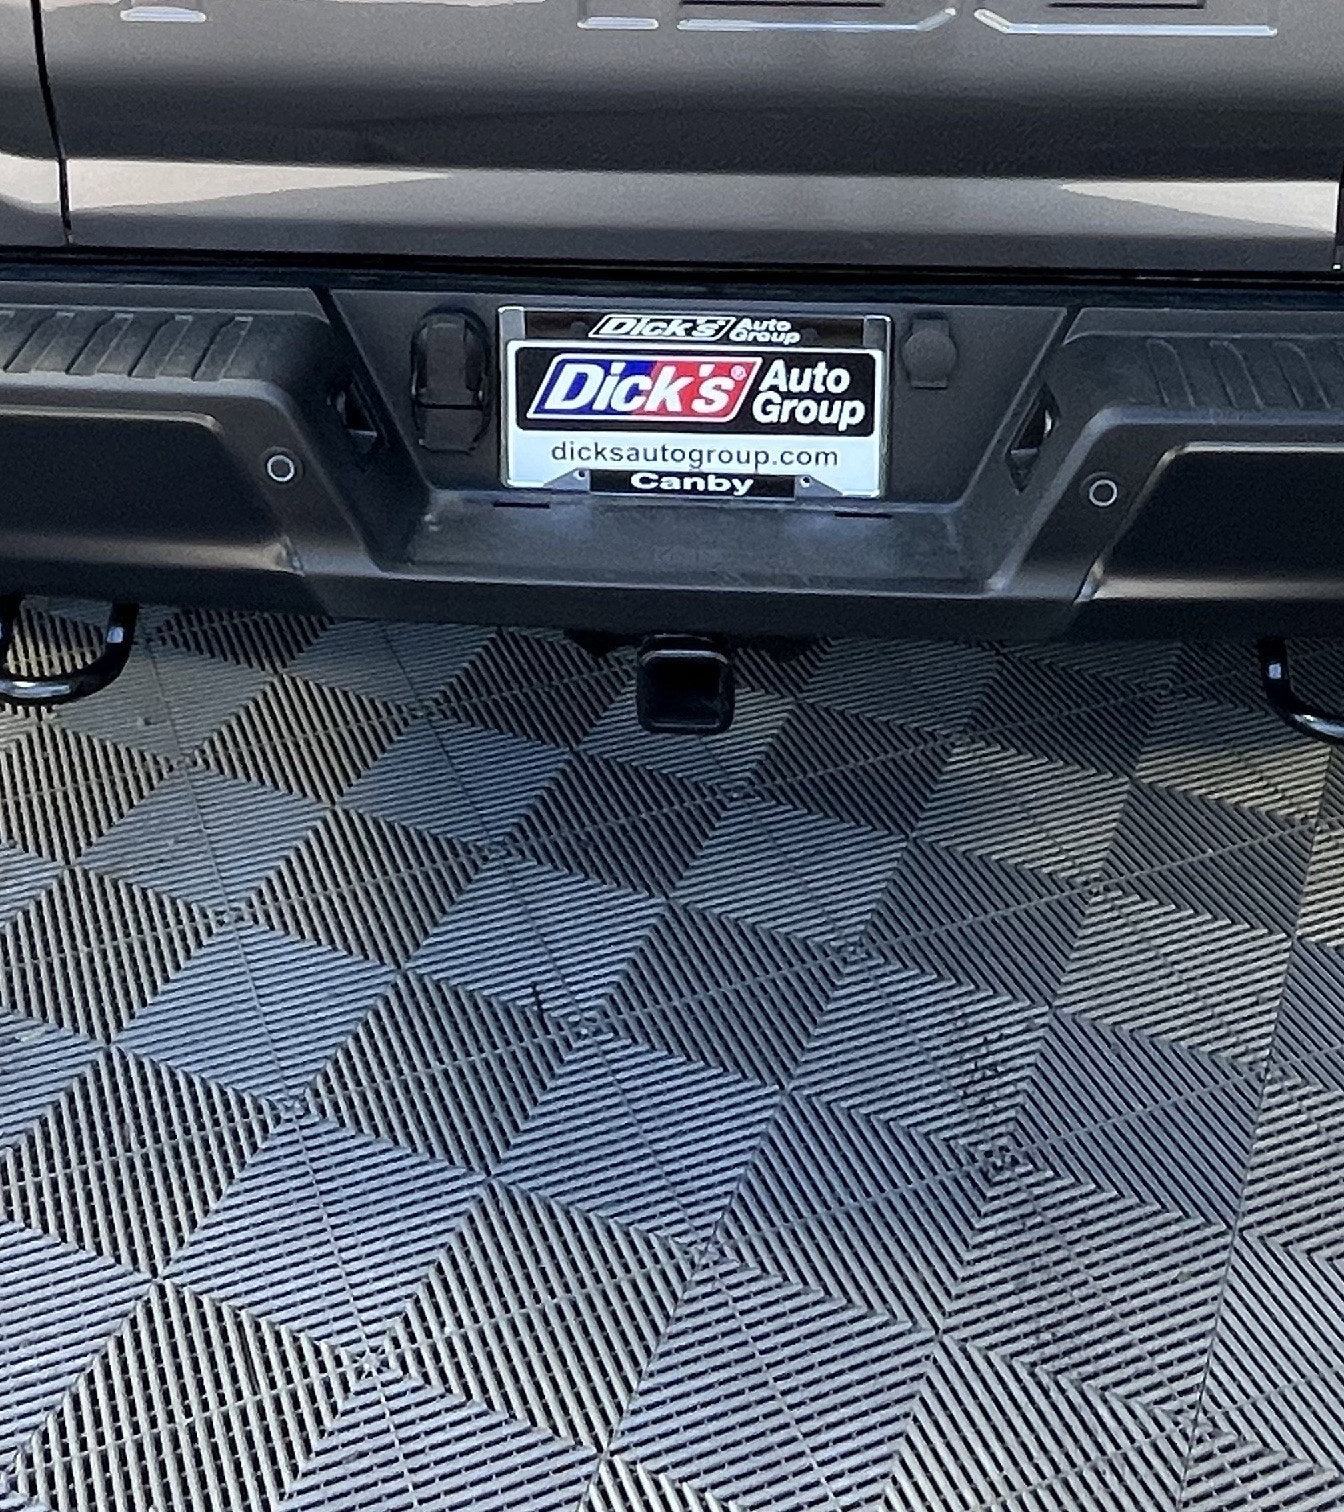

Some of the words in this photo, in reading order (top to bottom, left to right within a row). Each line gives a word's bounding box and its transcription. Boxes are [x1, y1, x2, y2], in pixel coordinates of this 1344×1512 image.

[599, 316, 727, 338] Dick's
[736, 317, 792, 333] Auto
[729, 329, 801, 345] Group
[543, 361, 737, 414] Dick's
[759, 360, 850, 394] Auto
[753, 395, 866, 431] Group
[551, 441, 838, 469] dicksautogroup.com
[630, 472, 754, 496] Canby
